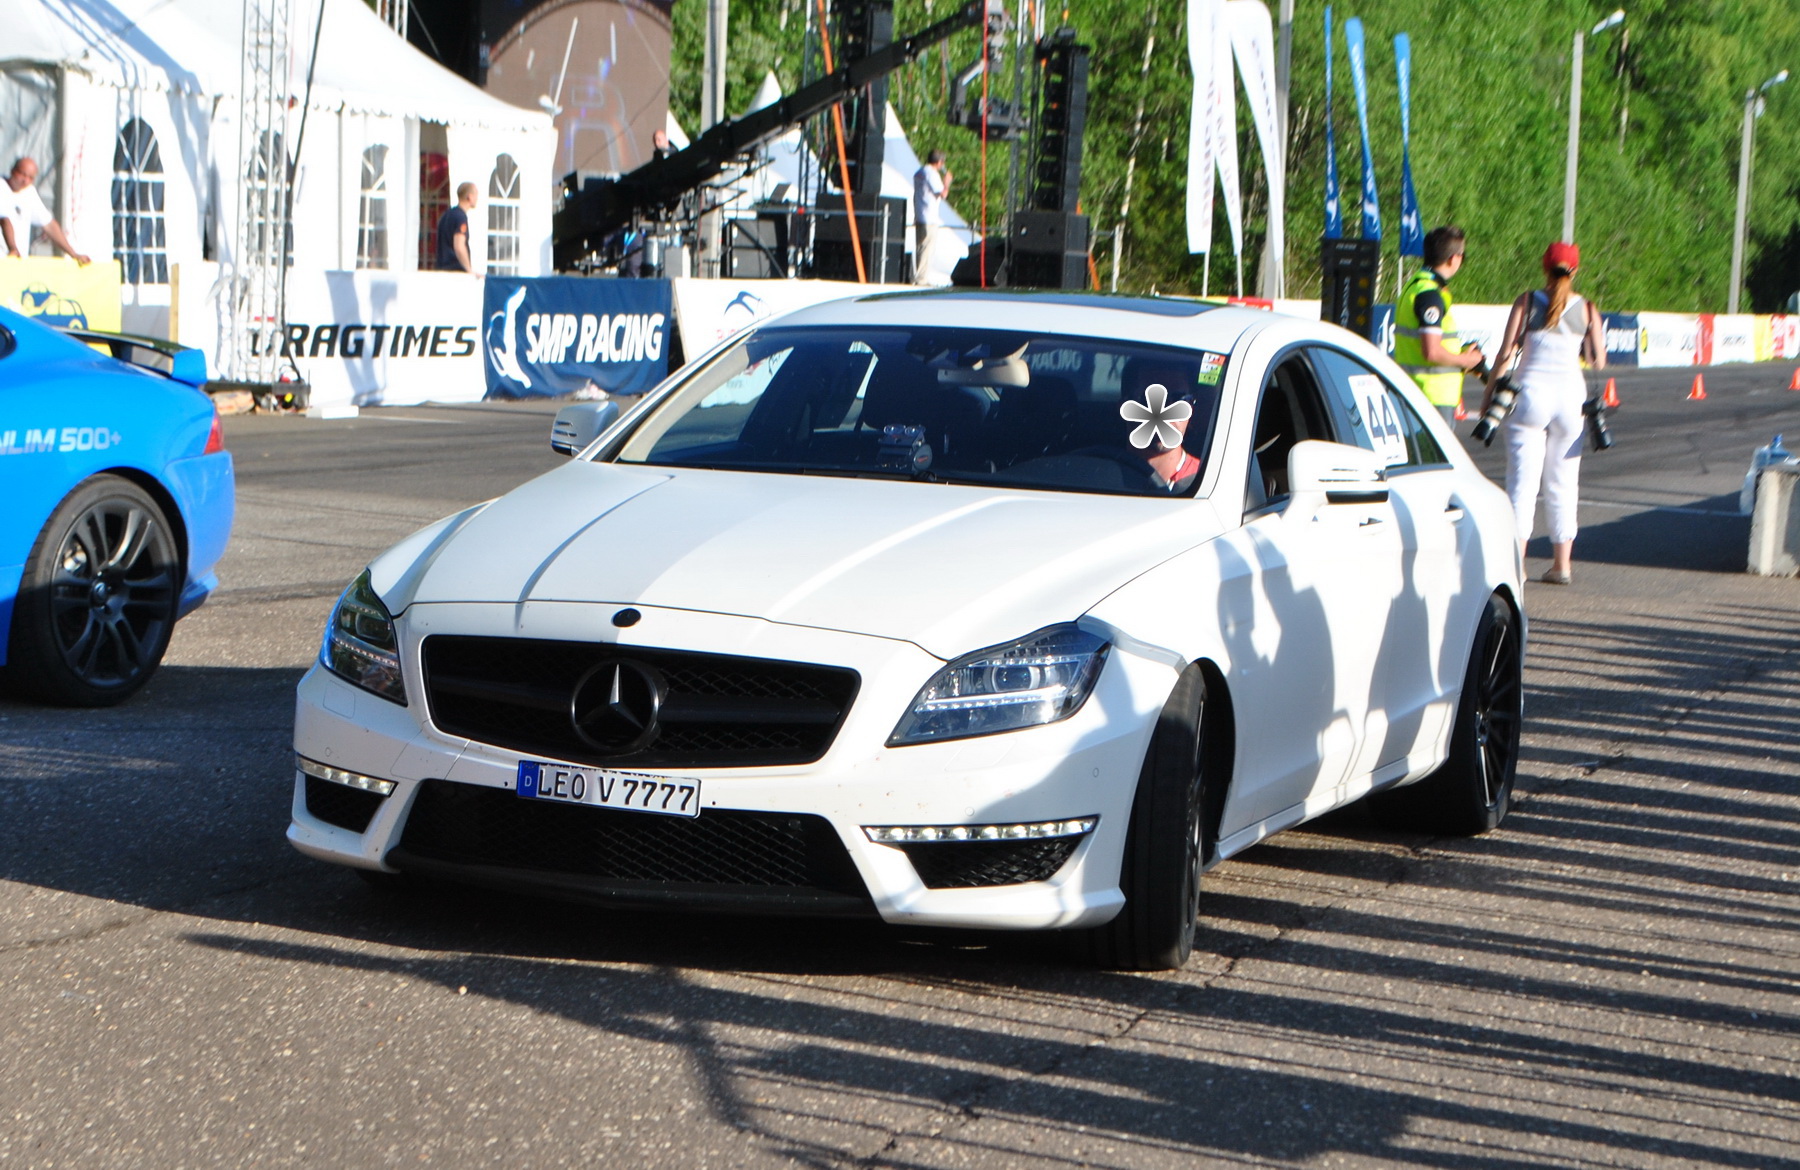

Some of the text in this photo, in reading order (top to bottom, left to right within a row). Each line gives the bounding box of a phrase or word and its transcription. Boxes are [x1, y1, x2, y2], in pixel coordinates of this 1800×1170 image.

[526, 313, 665, 364] SMP RACING
[59, 427, 122, 452] 500+
[1366, 394, 1400, 445] 44
[524, 769, 695, 811] D LEO V 7777
